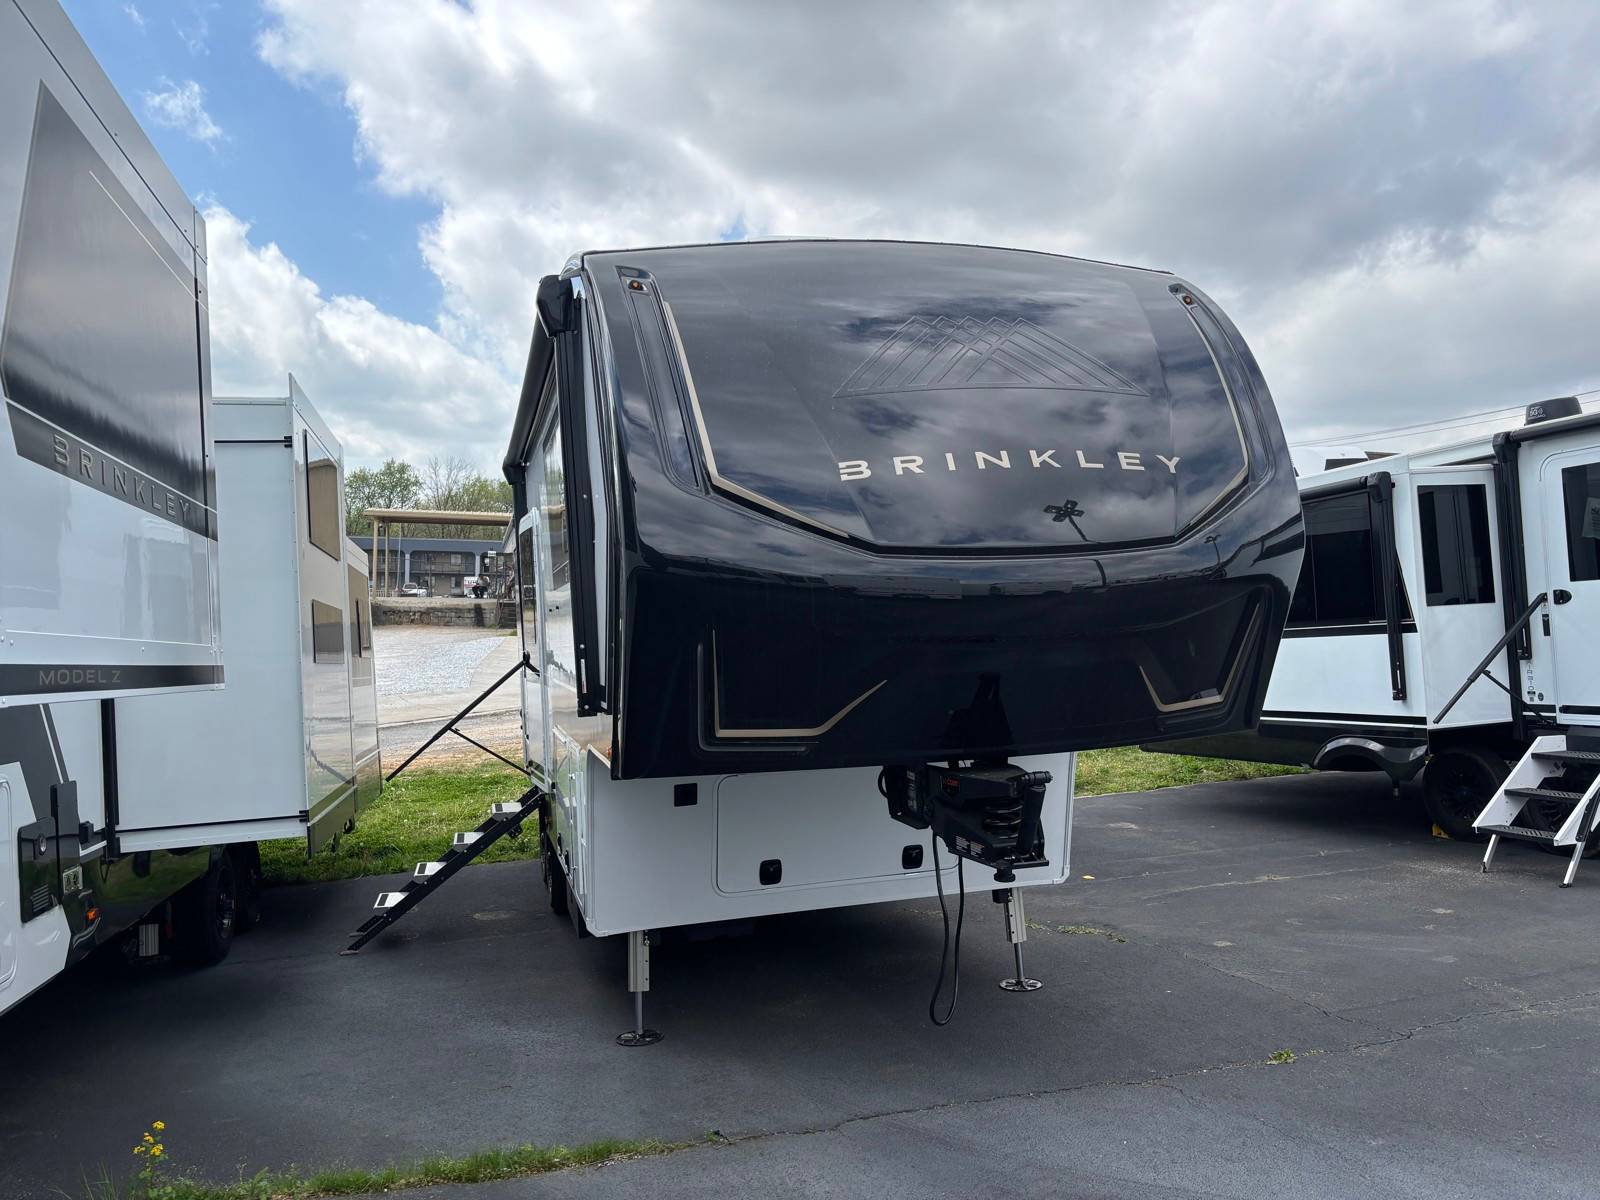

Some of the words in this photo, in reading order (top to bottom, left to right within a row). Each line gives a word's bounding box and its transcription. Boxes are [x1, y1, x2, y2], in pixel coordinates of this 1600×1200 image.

[53, 433, 192, 522] BRINKLEY
[837, 449, 1181, 482] BRINKLEY
[39, 669, 107, 686] MODEL
[111, 670, 121, 683] Z
